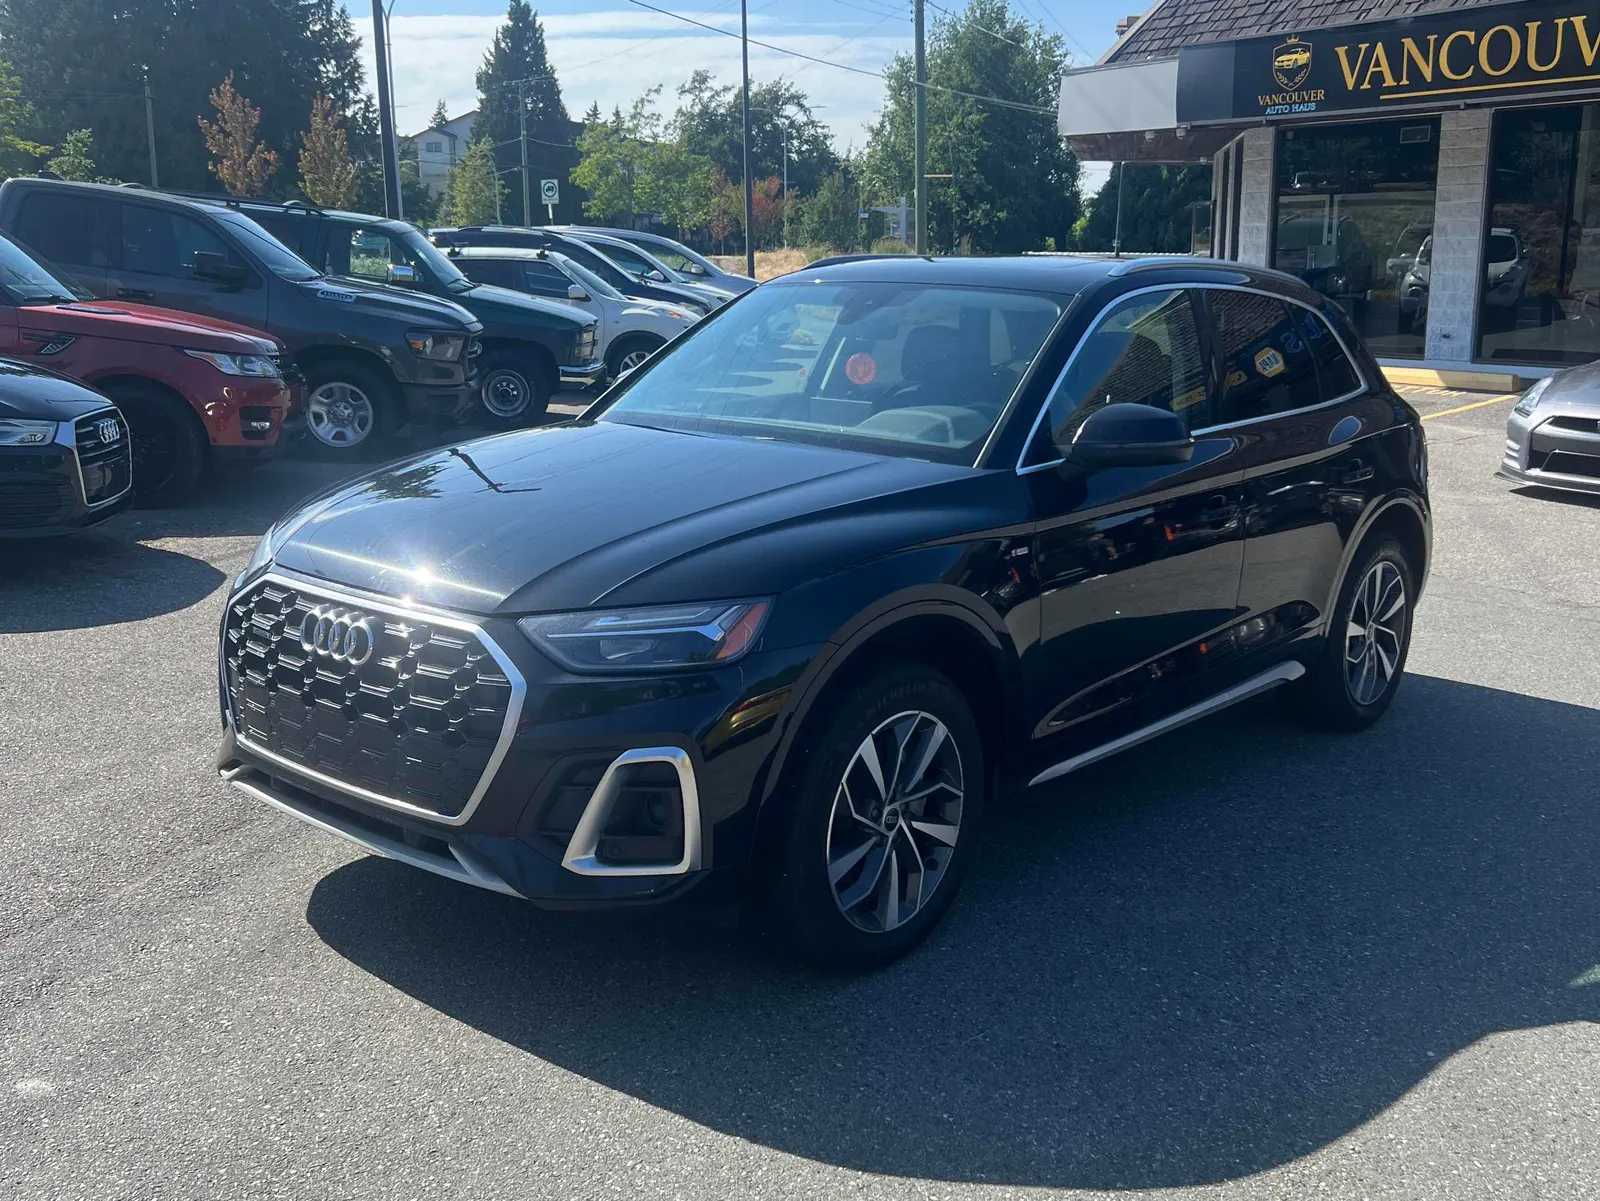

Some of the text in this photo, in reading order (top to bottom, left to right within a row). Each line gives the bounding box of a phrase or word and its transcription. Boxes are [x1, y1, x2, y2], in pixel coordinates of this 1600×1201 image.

[1334, 15, 1600, 90] VANCOUV
[1258, 89, 1325, 106] VANCOUVER
[1265, 102, 1316, 115] AUTO HAUS
